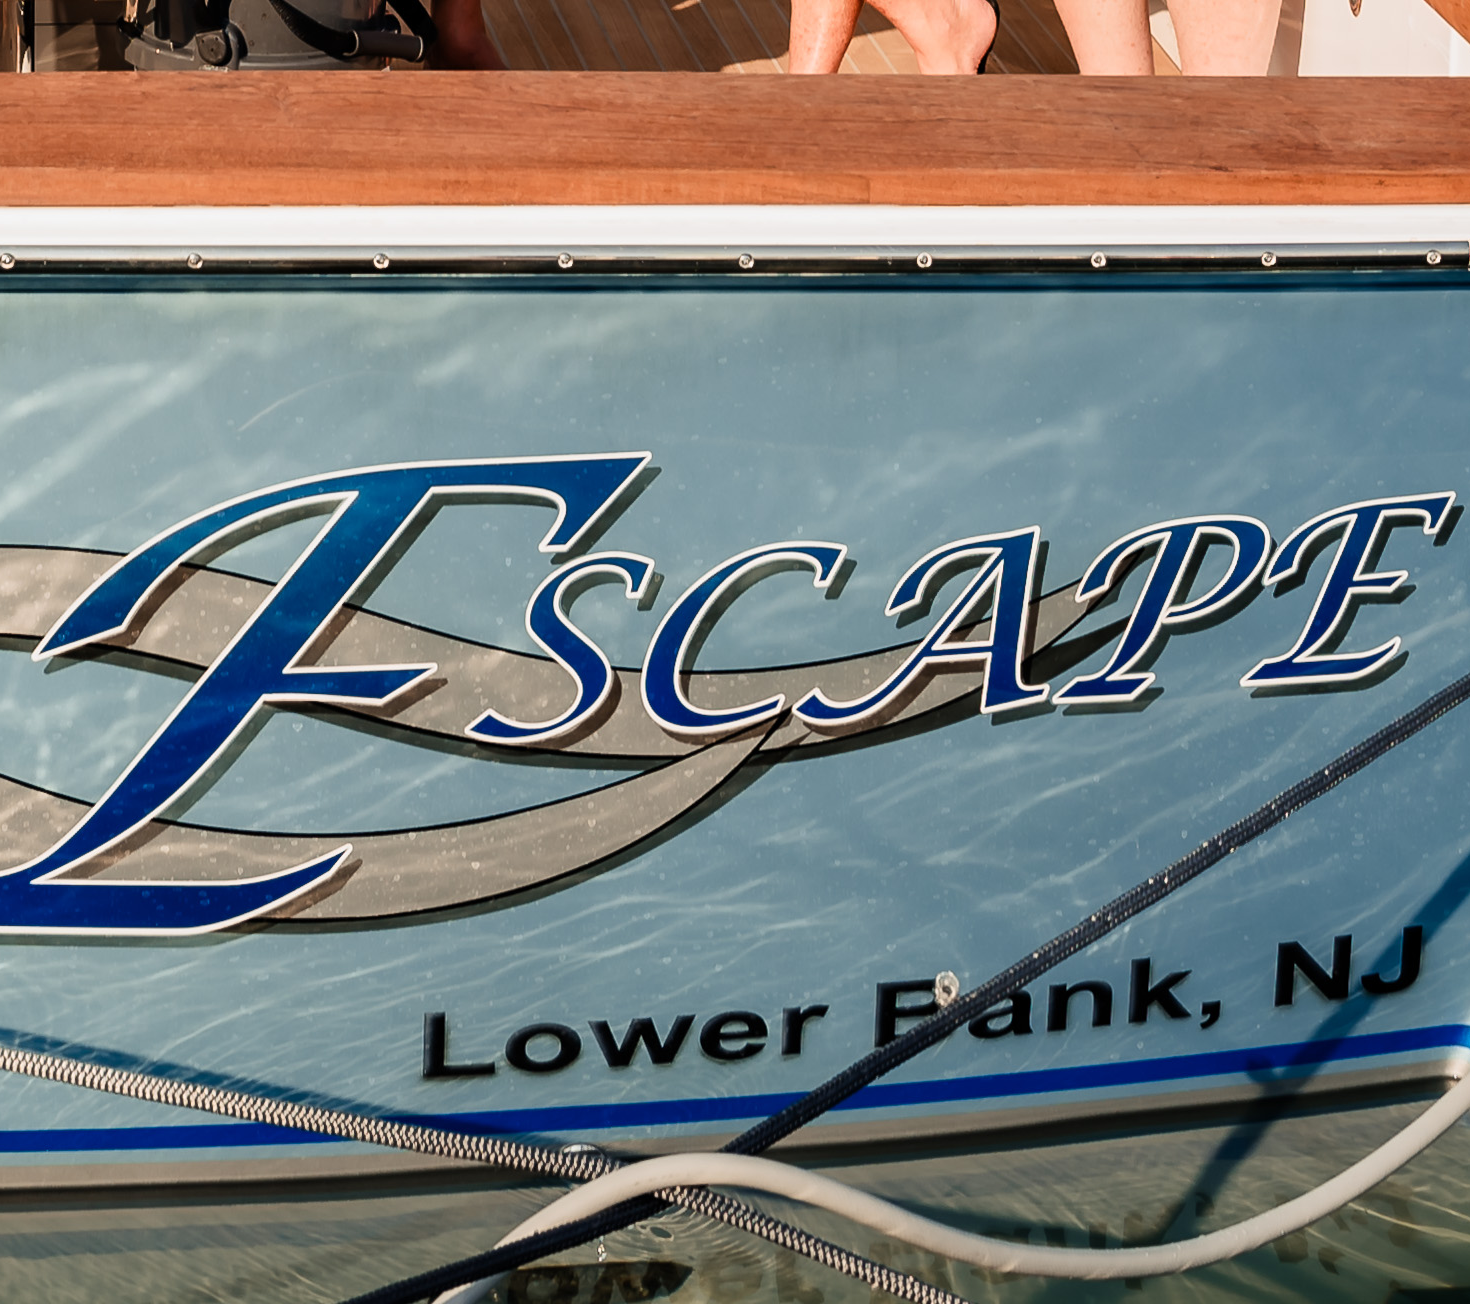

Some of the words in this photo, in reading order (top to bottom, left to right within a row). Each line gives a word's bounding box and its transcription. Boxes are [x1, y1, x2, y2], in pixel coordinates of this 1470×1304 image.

[422, 1004, 828, 1080] Lower
[873, 957, 1221, 1048] Bank,
[1274, 925, 1425, 1008] NJ
